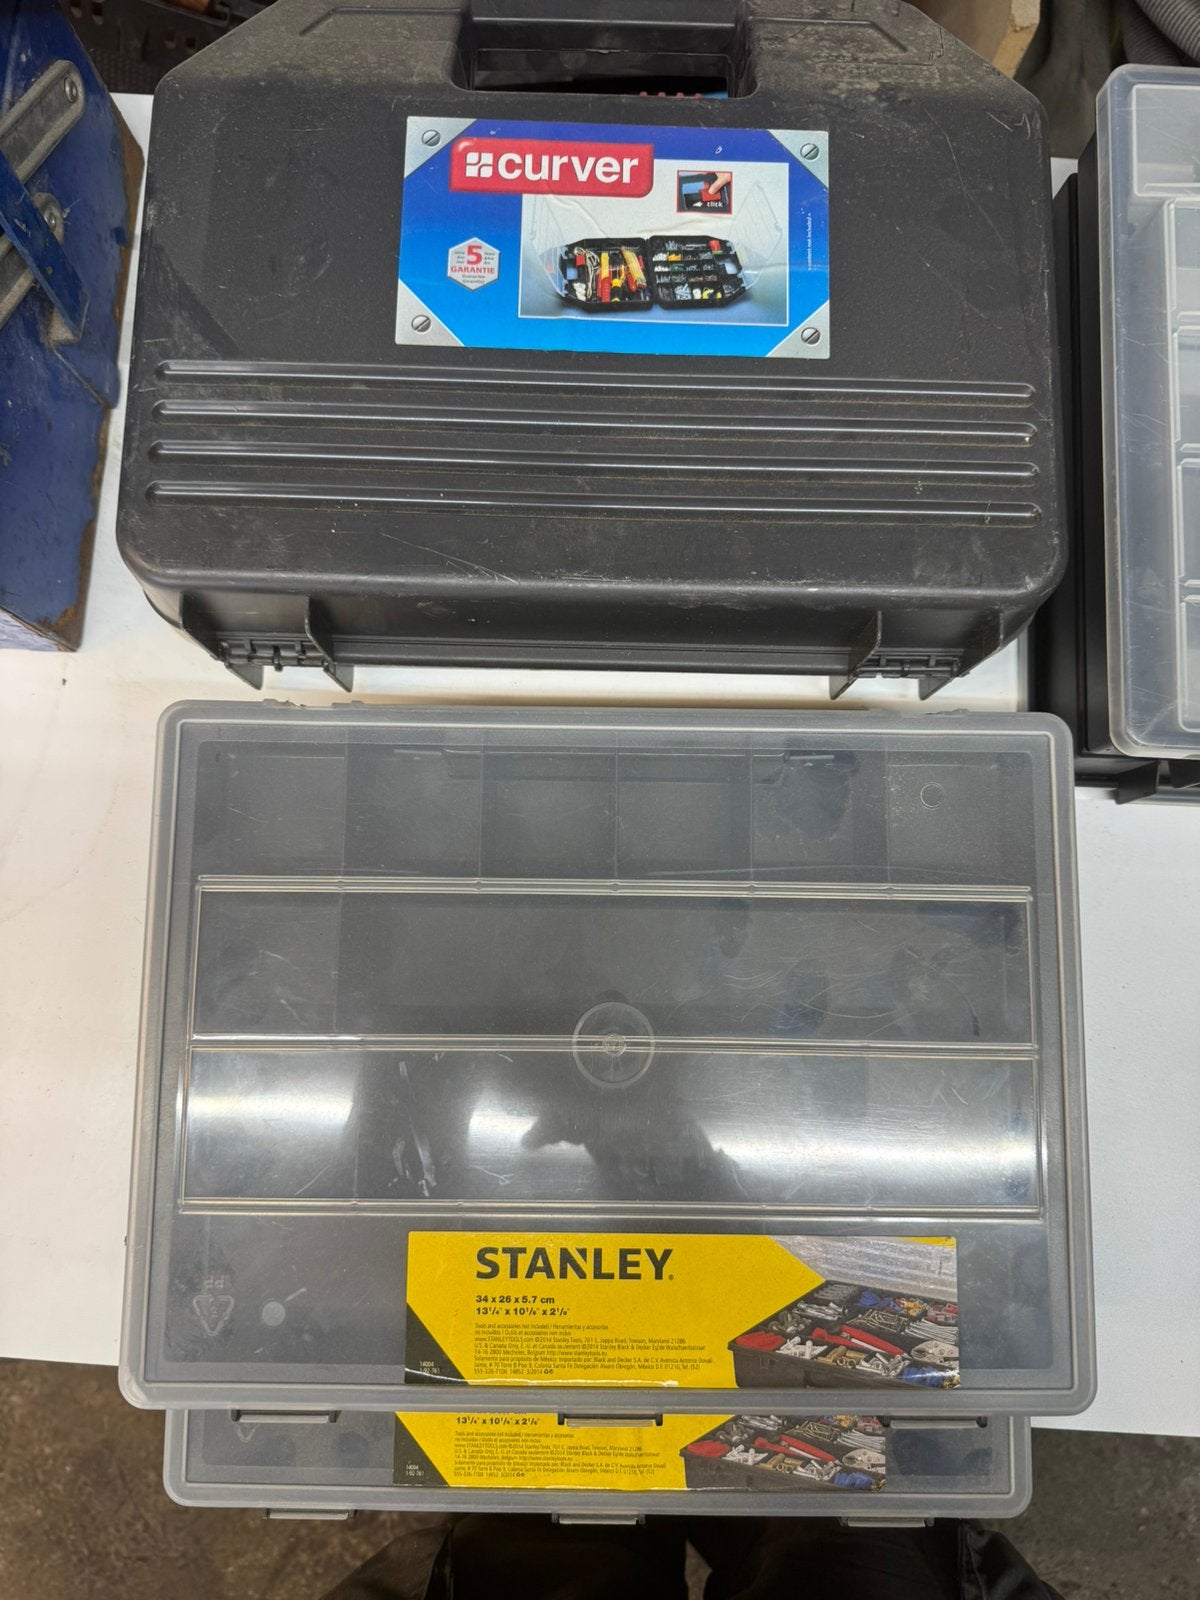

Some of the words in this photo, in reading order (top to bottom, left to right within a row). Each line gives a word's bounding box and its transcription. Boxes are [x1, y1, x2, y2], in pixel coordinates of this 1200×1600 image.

[498, 152, 638, 184] curver
[466, 245, 482, 266] 5
[450, 266, 495, 274] GARANTIE
[476, 1247, 673, 1280] STANLEY
[476, 1295, 489, 1304] 34
[499, 1296, 512, 1304] 26
[522, 1296, 537, 1304] 5.7
